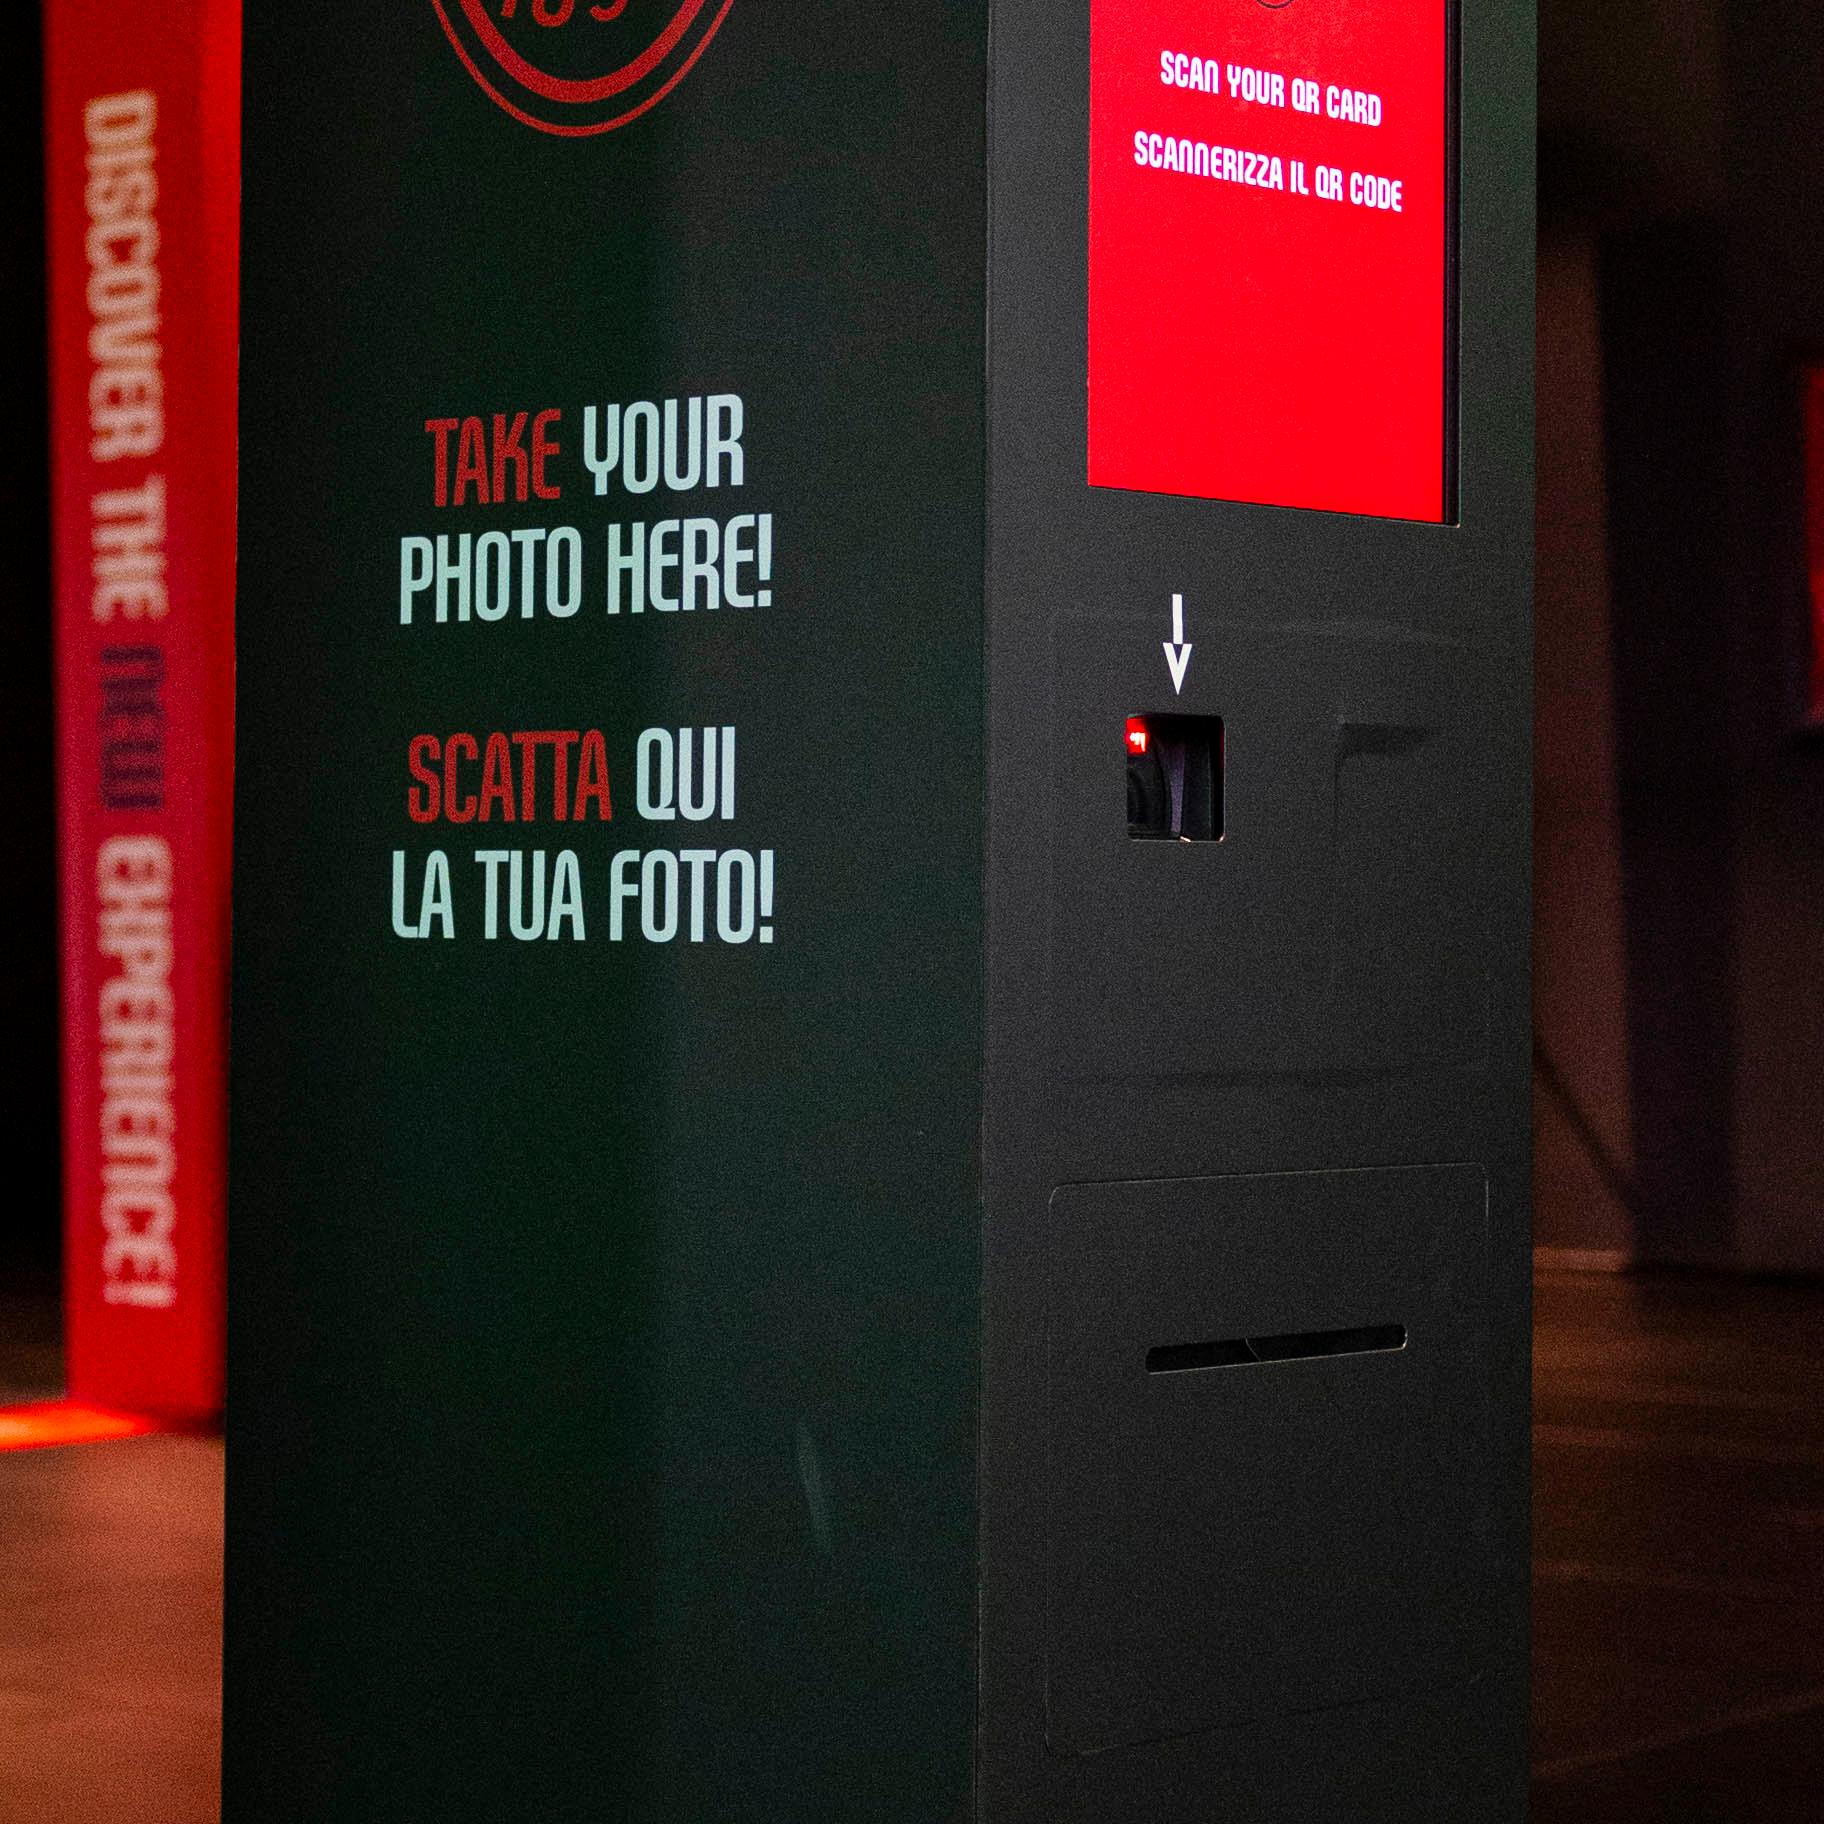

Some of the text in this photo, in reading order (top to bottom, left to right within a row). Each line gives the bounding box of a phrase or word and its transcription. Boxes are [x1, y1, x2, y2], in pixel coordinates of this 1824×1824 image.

[1160, 50, 1382, 127] SCAN YOUR QR CARD
[1133, 130, 1402, 212] SCANNERIZZA IL QR CODE
[84, 89, 166, 463] DISCOVER
[424, 393, 744, 507] TAKE YOUR
[91, 473, 169, 623] THE
[399, 513, 772, 625] PHOTO HERE!
[407, 726, 736, 824] SCATTA QUI
[392, 849, 774, 944] LA TUA FOTO!
[96, 835, 176, 1308] EXPERIENCE!
